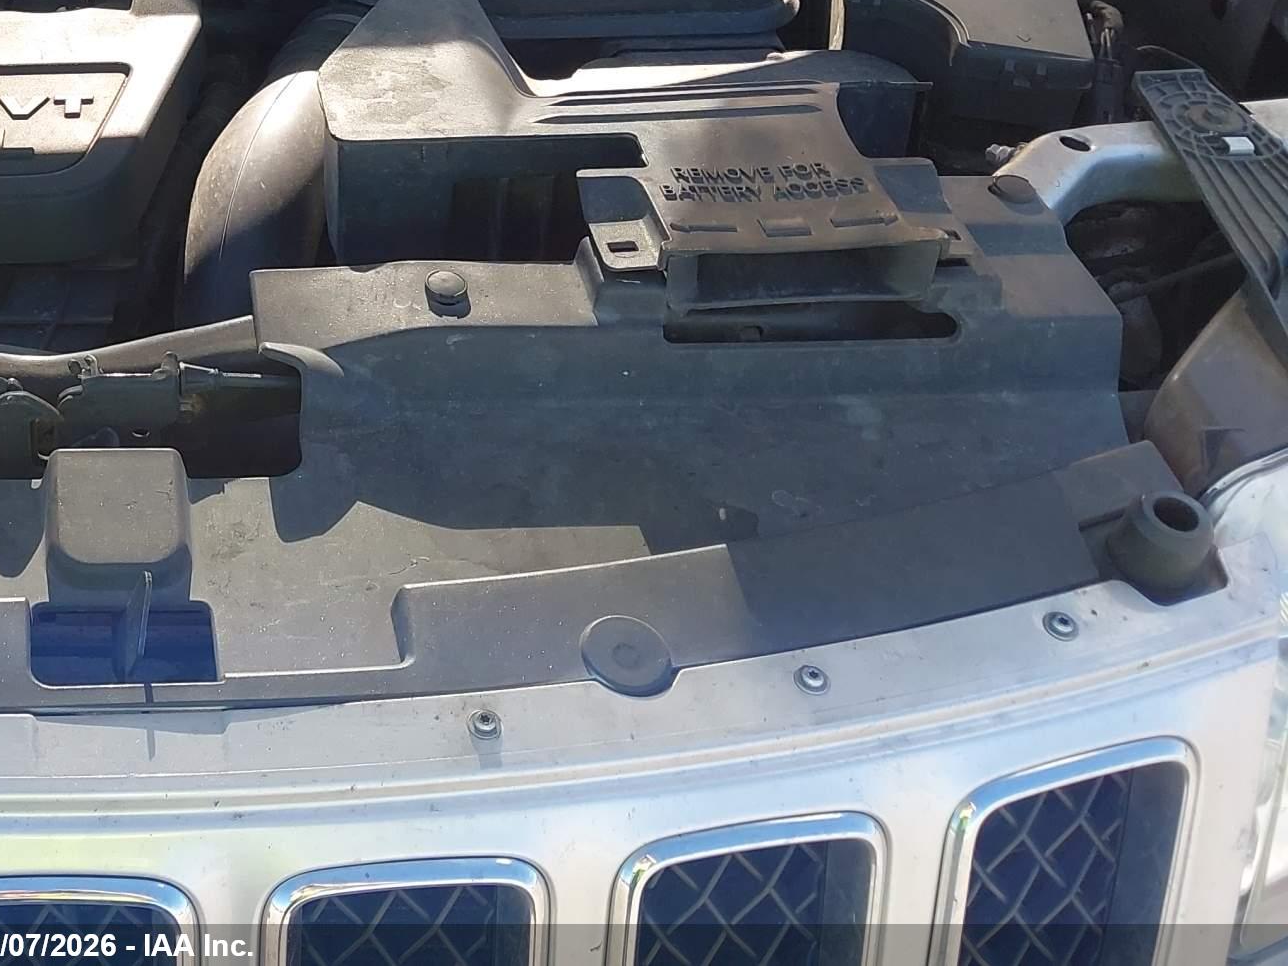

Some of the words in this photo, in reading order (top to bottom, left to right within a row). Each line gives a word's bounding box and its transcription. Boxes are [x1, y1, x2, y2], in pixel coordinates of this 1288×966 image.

[671, 166, 776, 185] REMOVE
[778, 162, 832, 182] FOR
[660, 184, 762, 203] BATTERY
[773, 177, 869, 202] ACCESS
